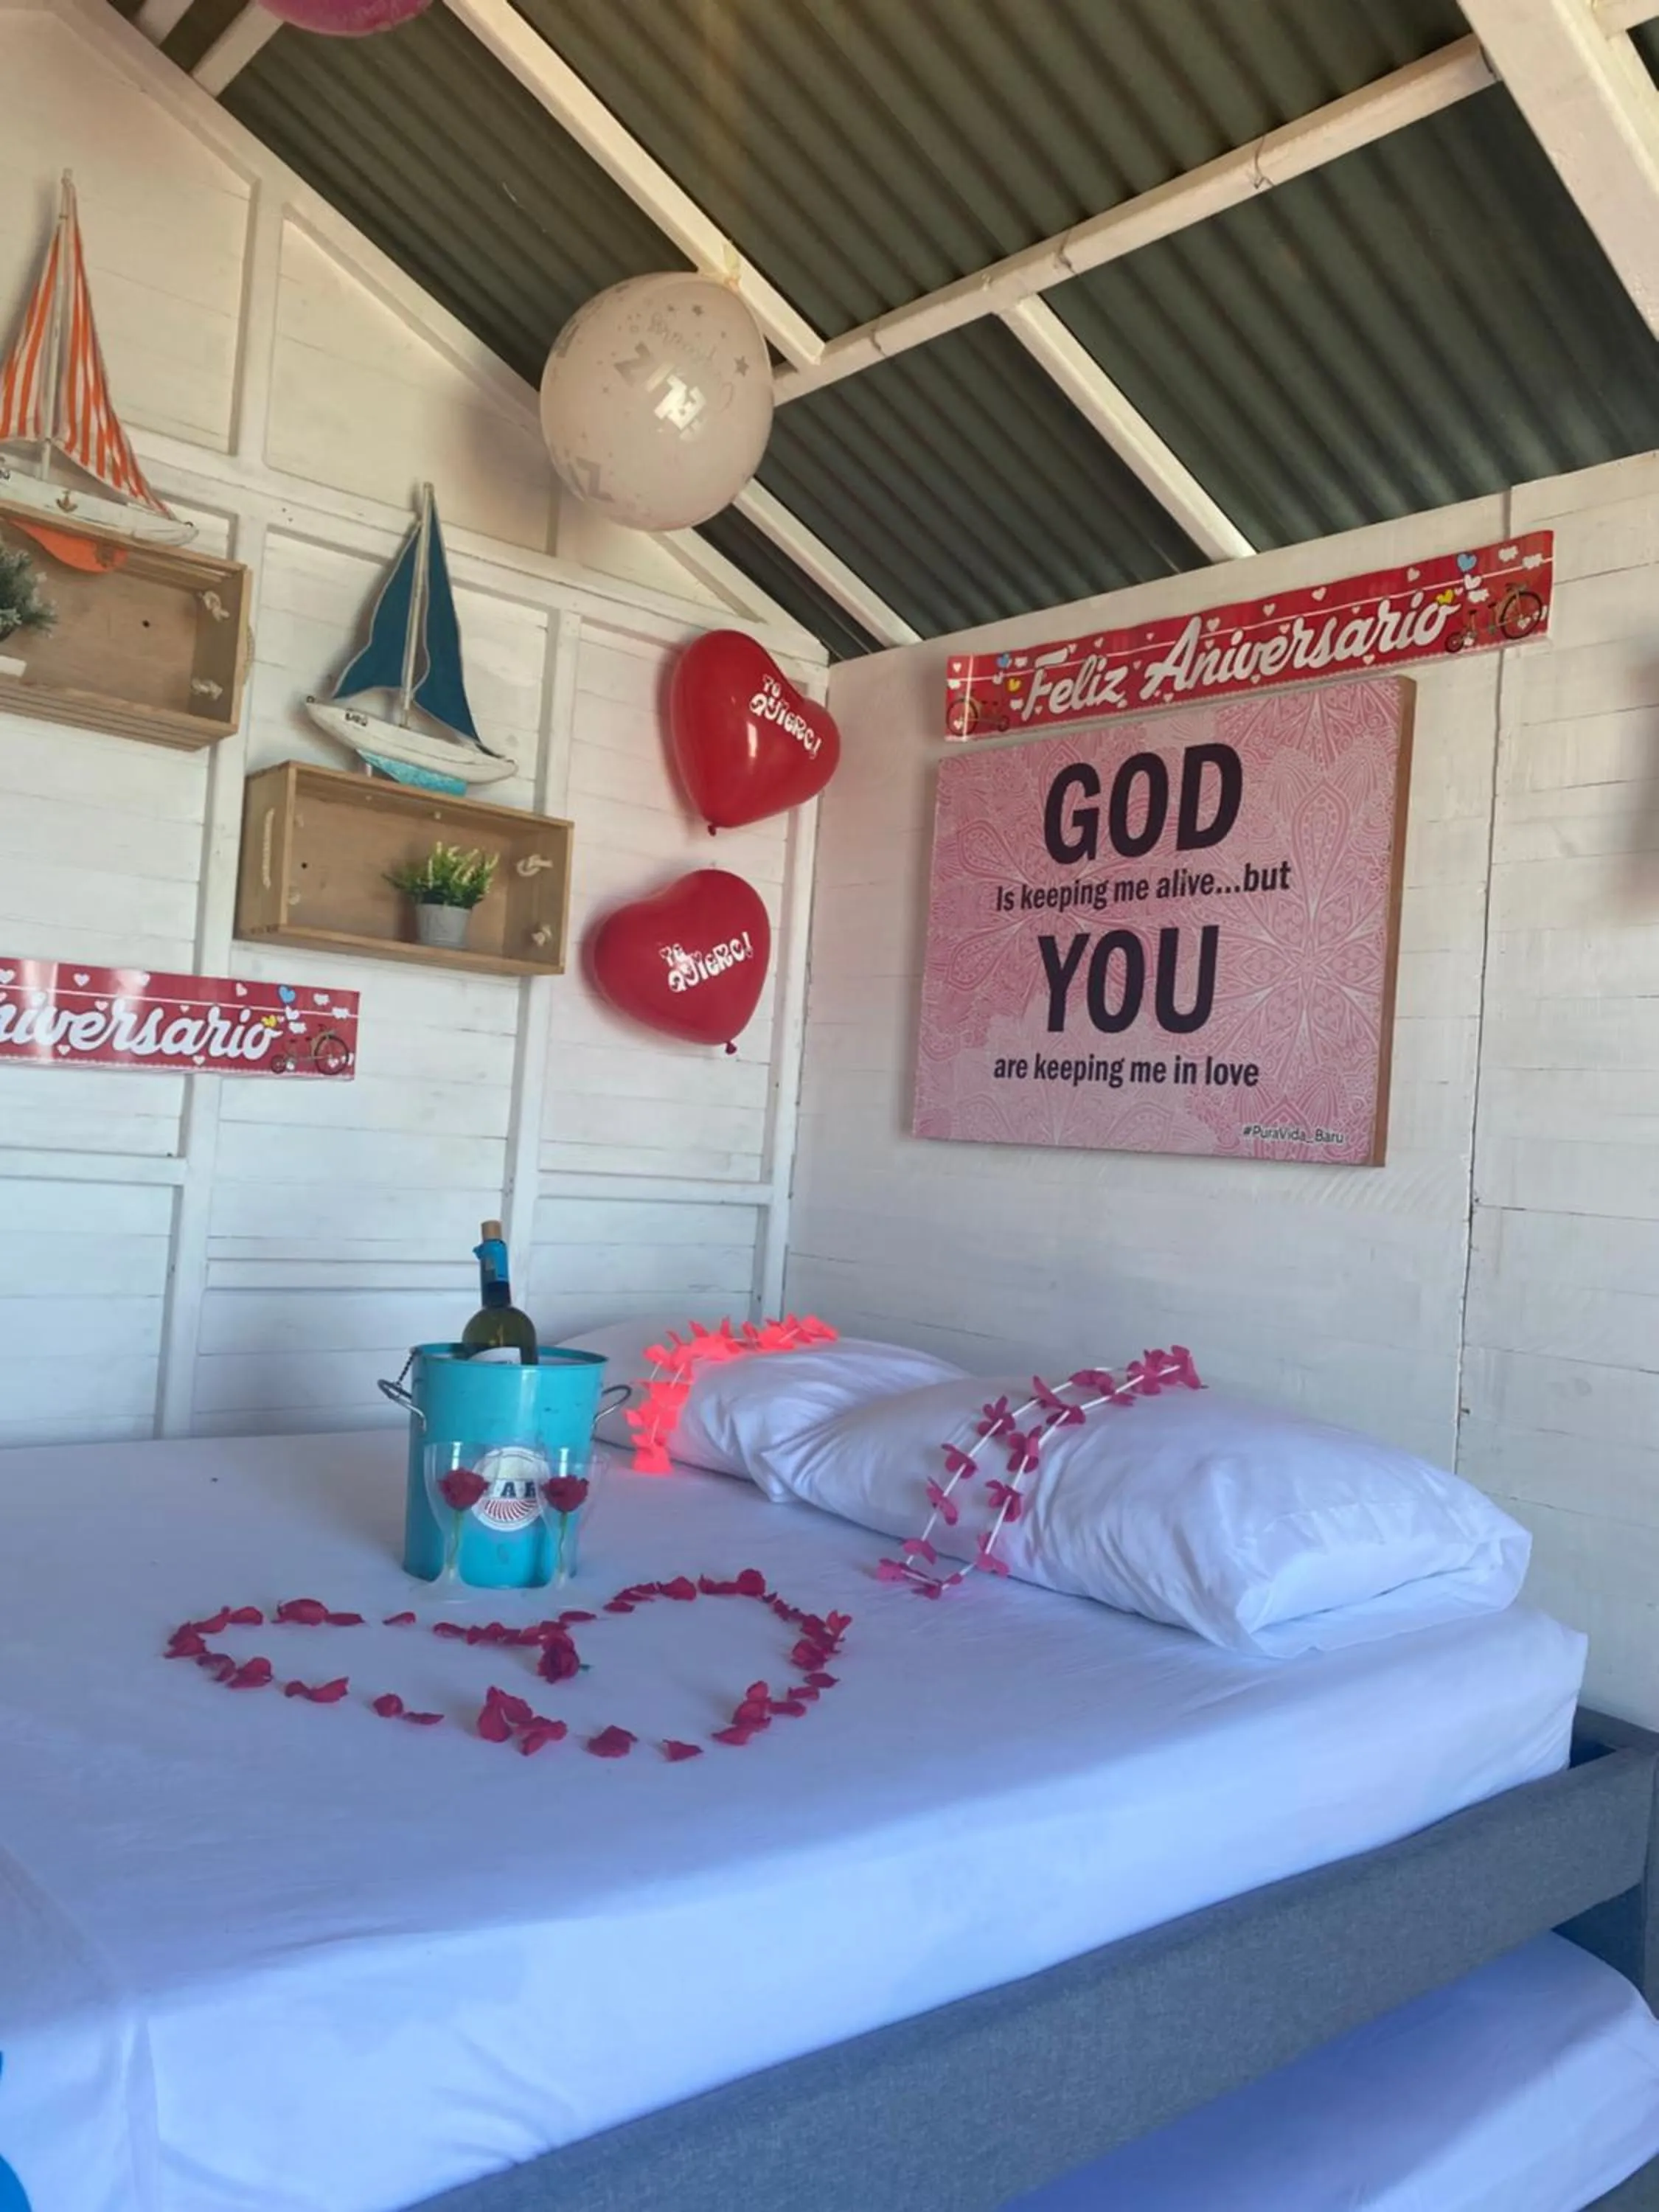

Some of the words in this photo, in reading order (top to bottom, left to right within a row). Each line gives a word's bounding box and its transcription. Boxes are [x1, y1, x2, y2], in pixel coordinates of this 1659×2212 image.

[1021, 647, 1127, 721] Feliz
[1139, 591, 1461, 700] Aniversario
[1044, 742, 1242, 864] GOD
[997, 888, 1014, 911] Is
[1020, 880, 1108, 912] keeping
[1113, 879, 1150, 902] me
[1037, 925, 1219, 1032] YOU
[994, 1057, 1028, 1079] are
[1033, 1053, 1125, 1088] keeping
[1130, 1060, 1166, 1083] me
[1174, 1055, 1197, 1085] in
[1206, 1056, 1260, 1087] love
